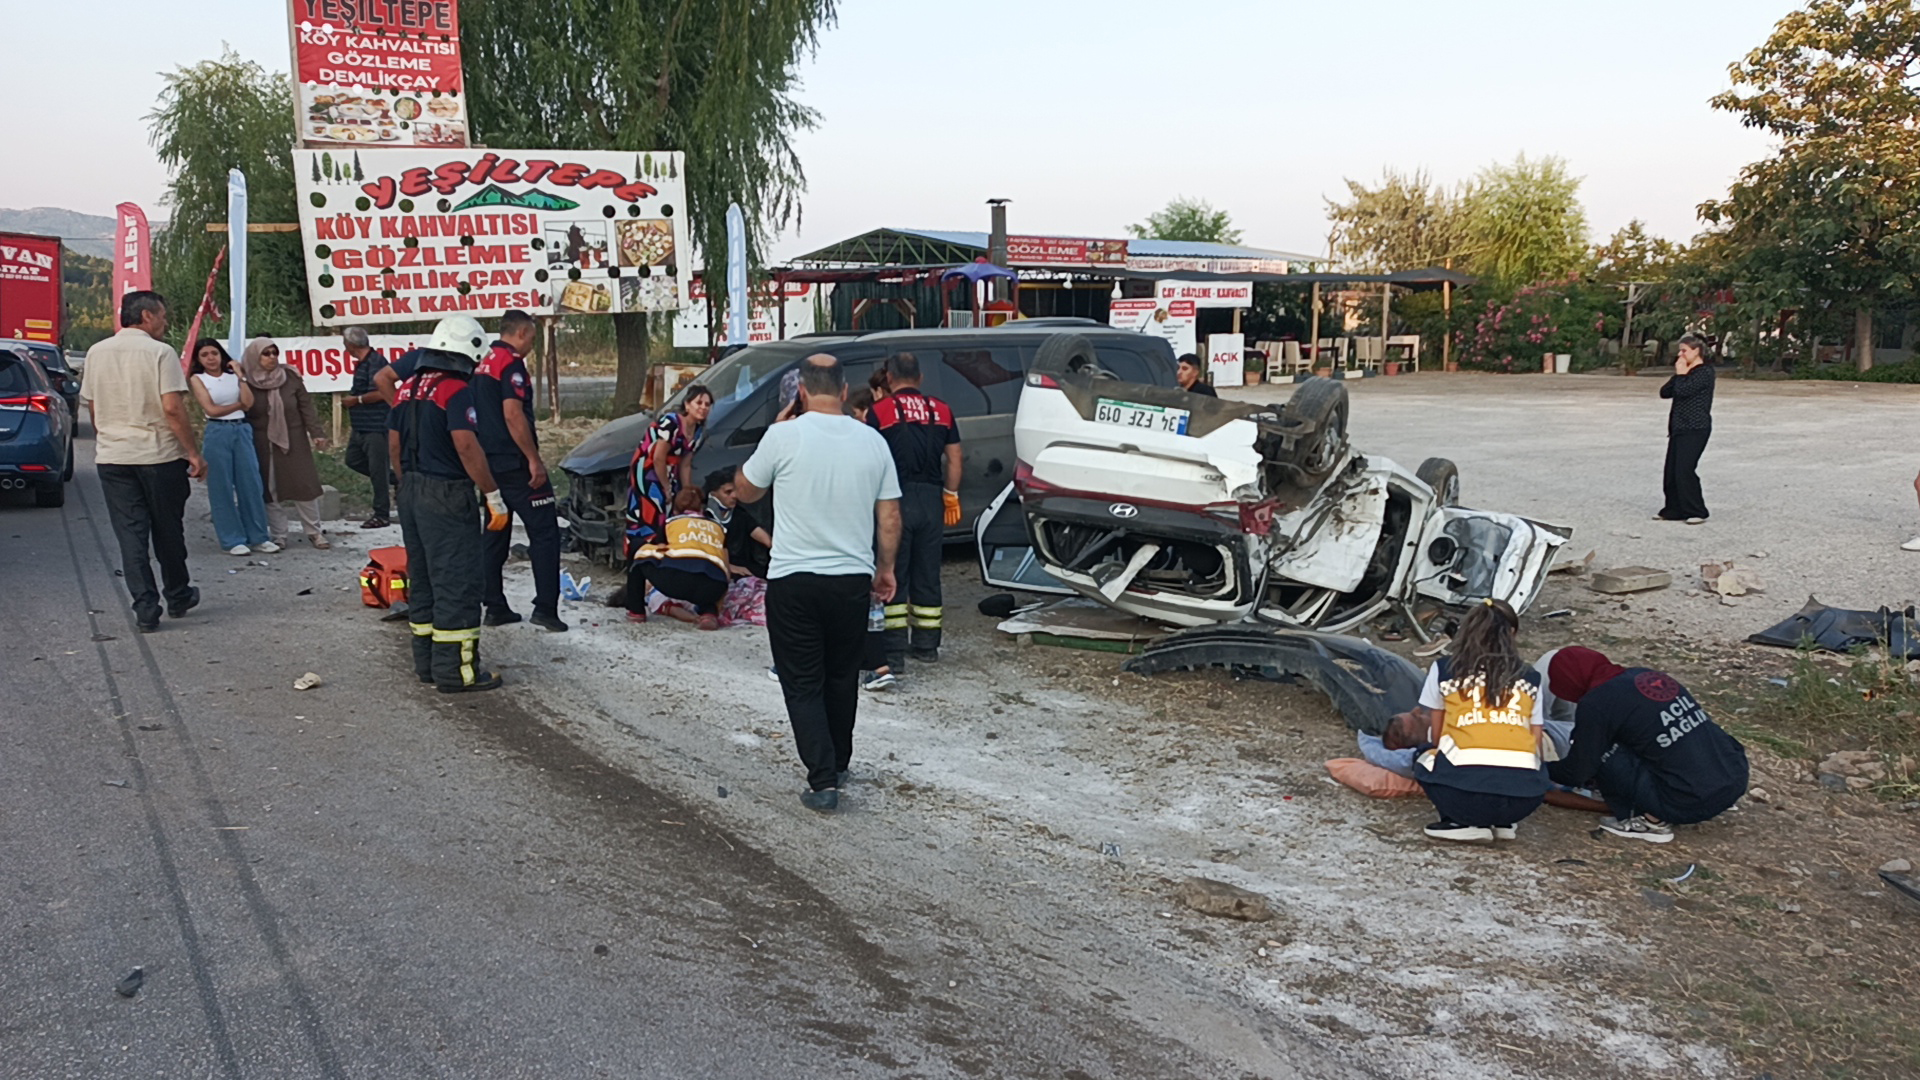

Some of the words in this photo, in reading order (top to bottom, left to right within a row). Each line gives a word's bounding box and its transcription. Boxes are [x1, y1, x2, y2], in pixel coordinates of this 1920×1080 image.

[300, 31, 341, 47] KÖY
[346, 36, 455, 55] KAHVALTISI
[327, 51, 432, 71] GÖZLEME
[319, 68, 441, 90] DEMLİKÇAY
[361, 152, 658, 209] YEŞİLTEPE
[315, 213, 372, 240] KÖY
[380, 213, 539, 240] KAHVALTISI
[331, 243, 532, 270] GÖZLEME
[1007, 244, 1079, 256] GÖZLEME
[342, 271, 461, 293] DEMLİK
[468, 269, 525, 291] ÇAY
[331, 295, 413, 318] TÜRK
[419, 289, 541, 314] KAHVESİ
[1213, 352, 1239, 365] AÇIK
[1099, 405, 1121, 423] 019
[1128, 410, 1154, 429] FZF
[1162, 416, 1177, 432] 34
